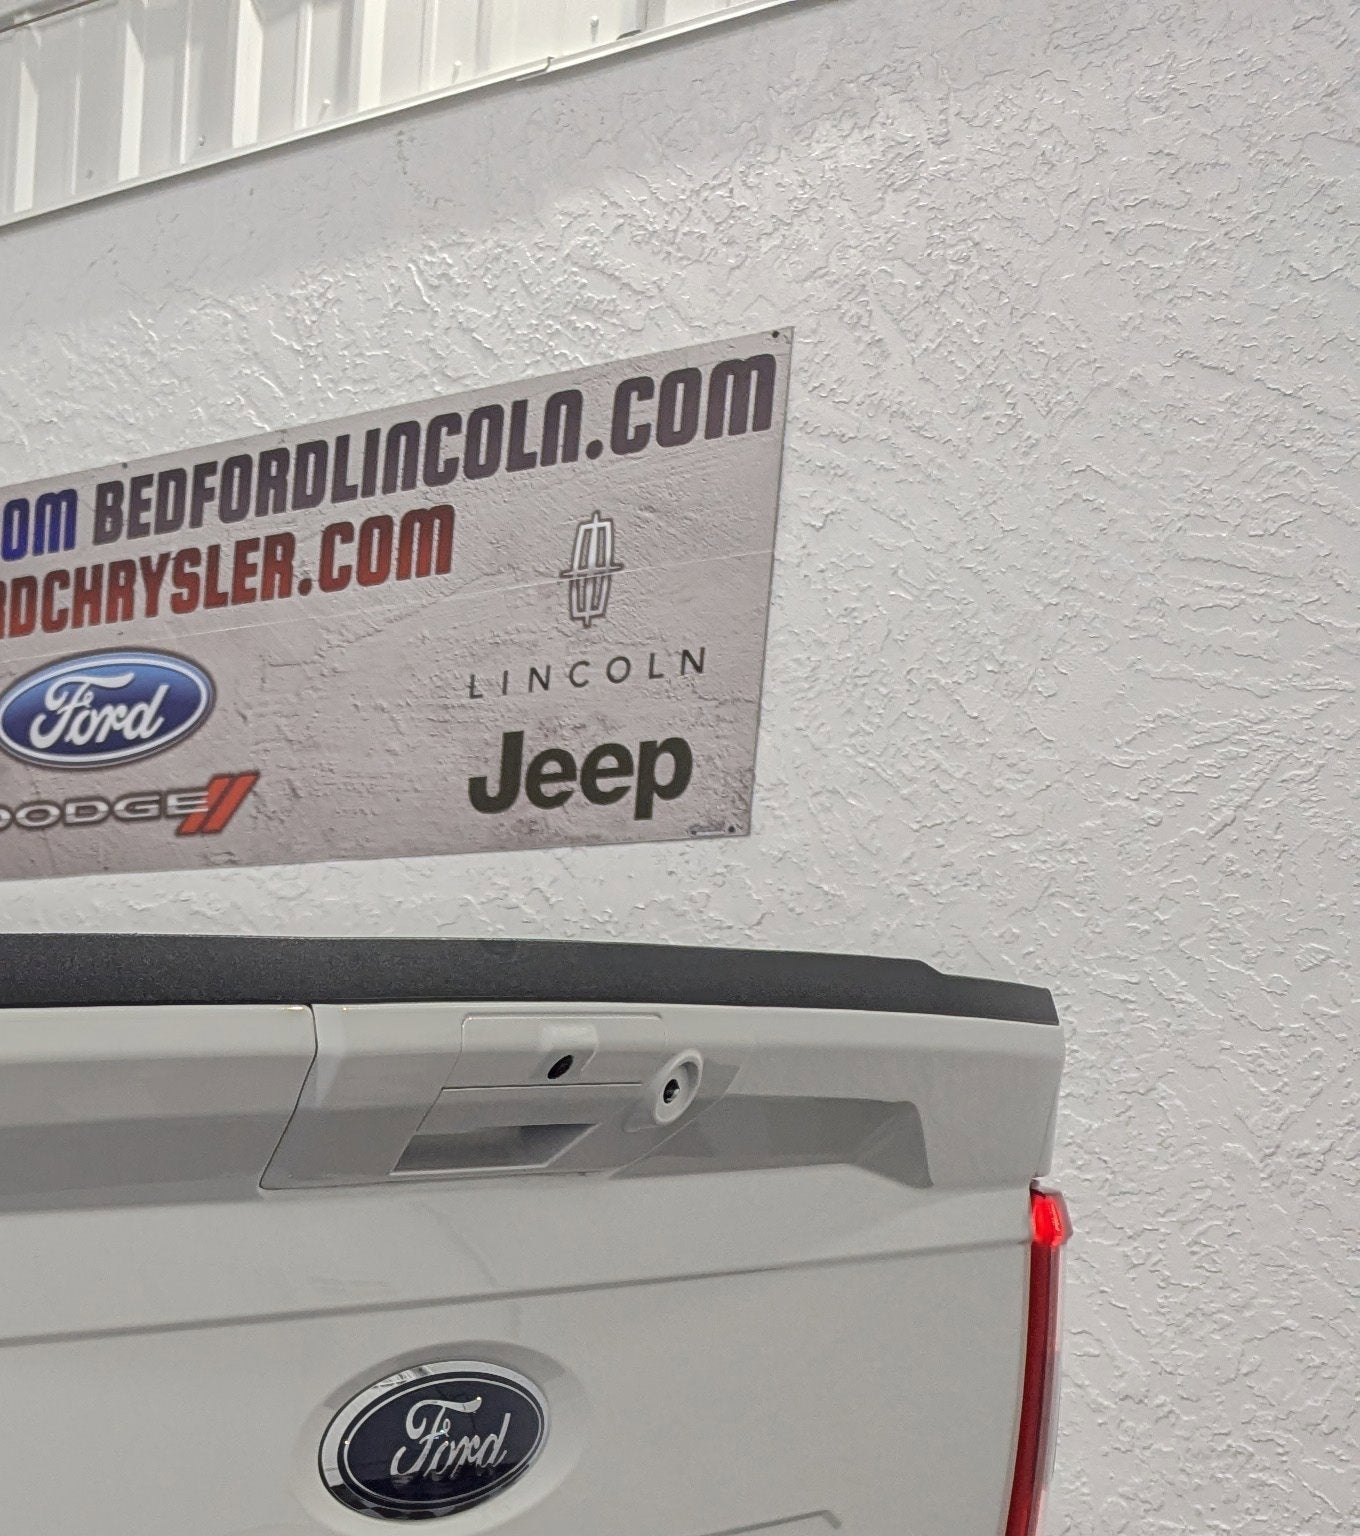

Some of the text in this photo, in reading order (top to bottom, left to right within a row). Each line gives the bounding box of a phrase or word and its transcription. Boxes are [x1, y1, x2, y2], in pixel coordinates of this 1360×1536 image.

[92, 353, 777, 546] BEDFORDLINCOLN.COM
[30, 672, 170, 749] Ford
[468, 646, 706, 700] LINCOLN
[468, 730, 693, 821] Jeep
[390, 1396, 512, 1486] Ford
